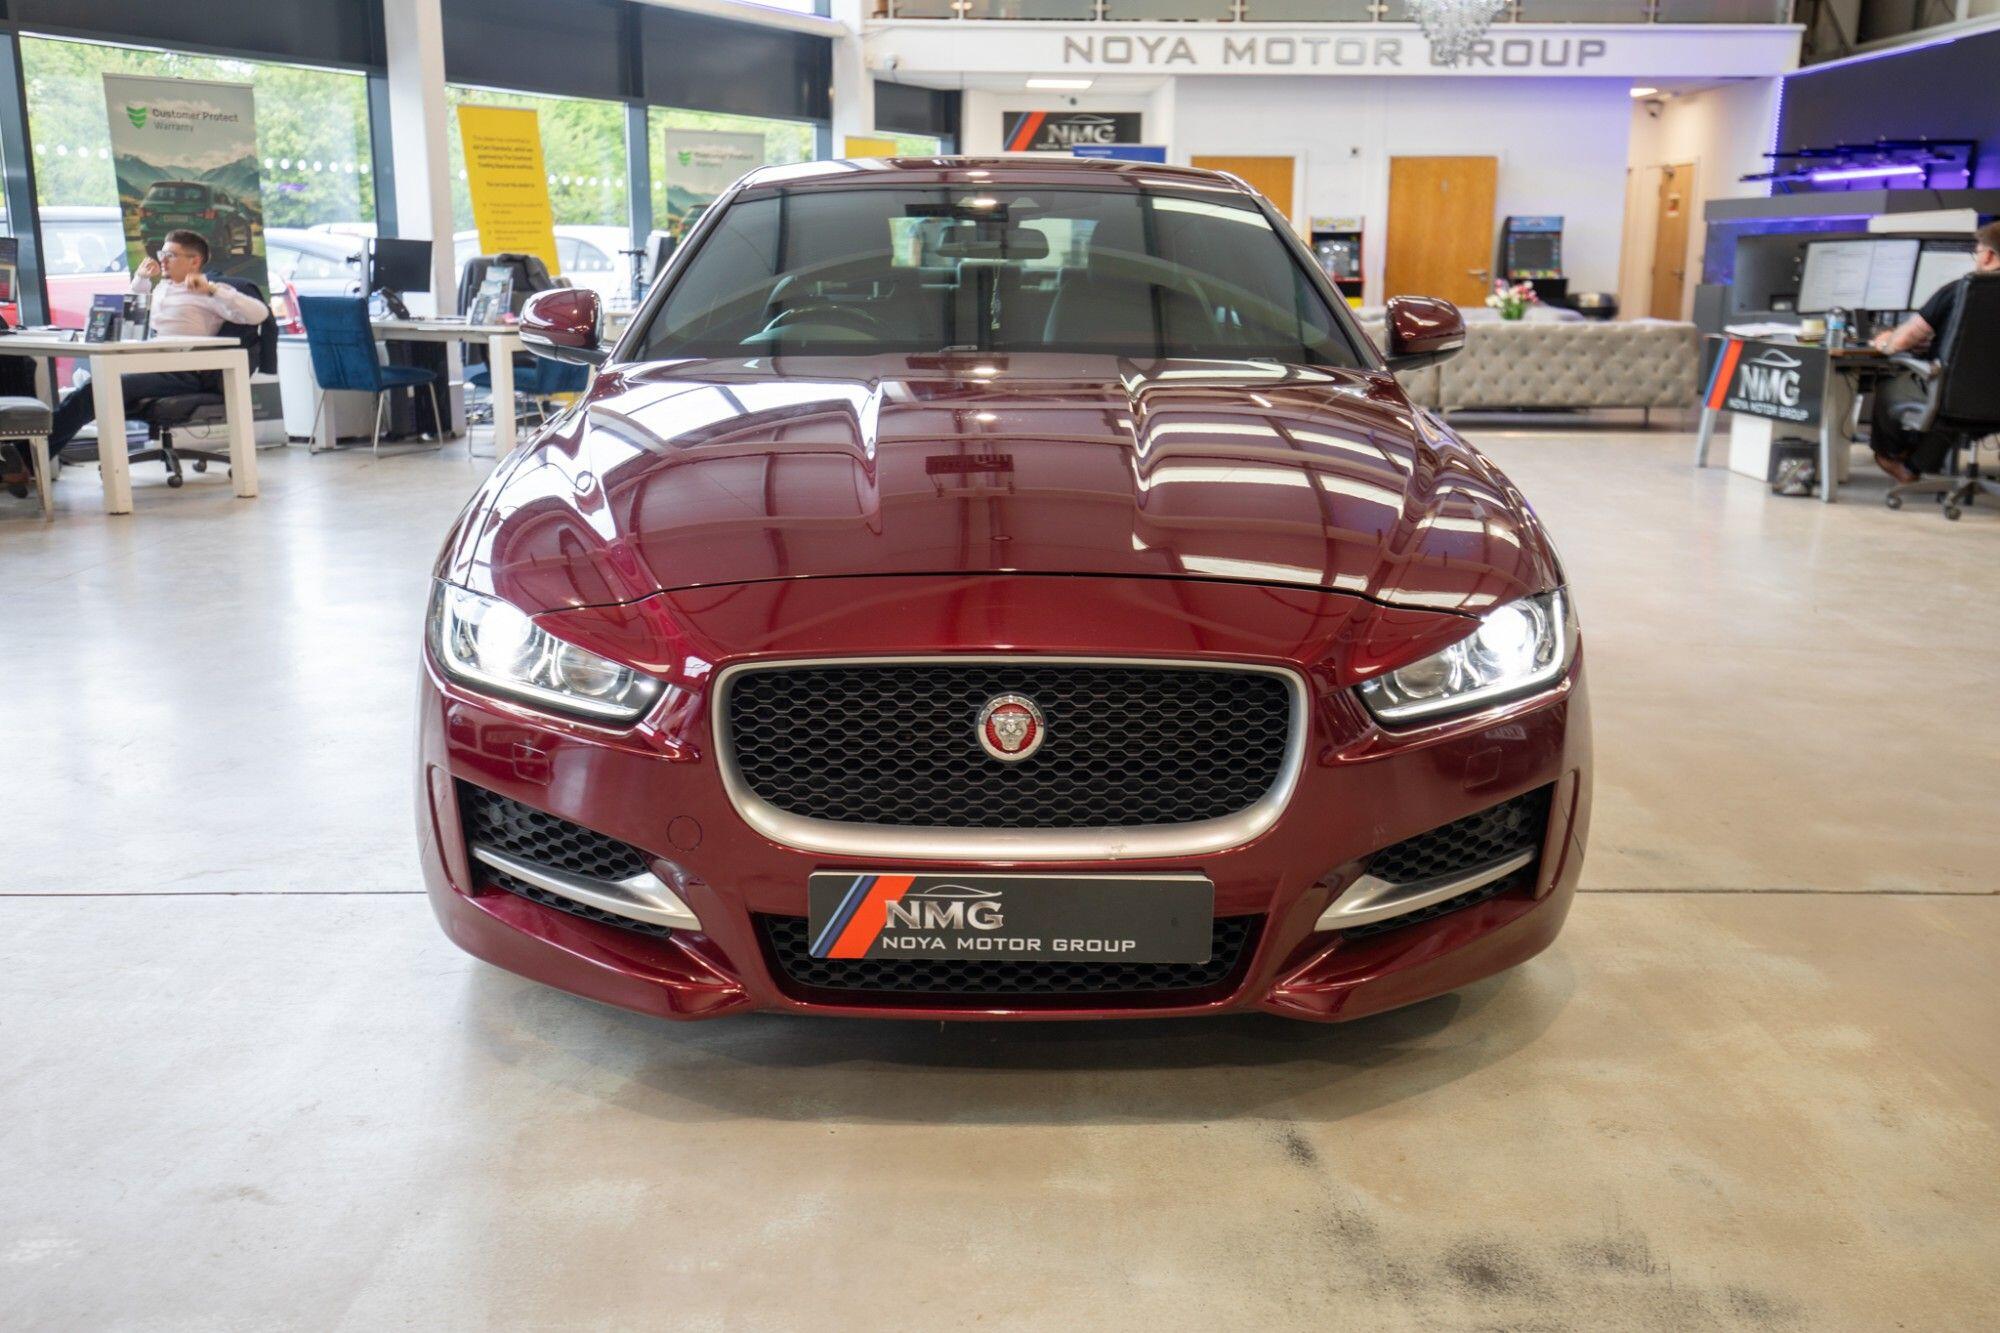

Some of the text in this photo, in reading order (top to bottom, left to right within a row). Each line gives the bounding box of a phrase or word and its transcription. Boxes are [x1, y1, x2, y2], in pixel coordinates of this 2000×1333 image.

[1063, 35, 1197, 65] NOYA
[1223, 36, 1403, 66] MOTOR
[152, 108, 239, 122] Customer Protect
[153, 121, 194, 132] Warranty
[1047, 124, 1116, 143] NMG
[1739, 364, 1800, 406] NMG
[884, 900, 1004, 930] NMG
[883, 937, 1136, 953] NOYA MOTOR GROUP
